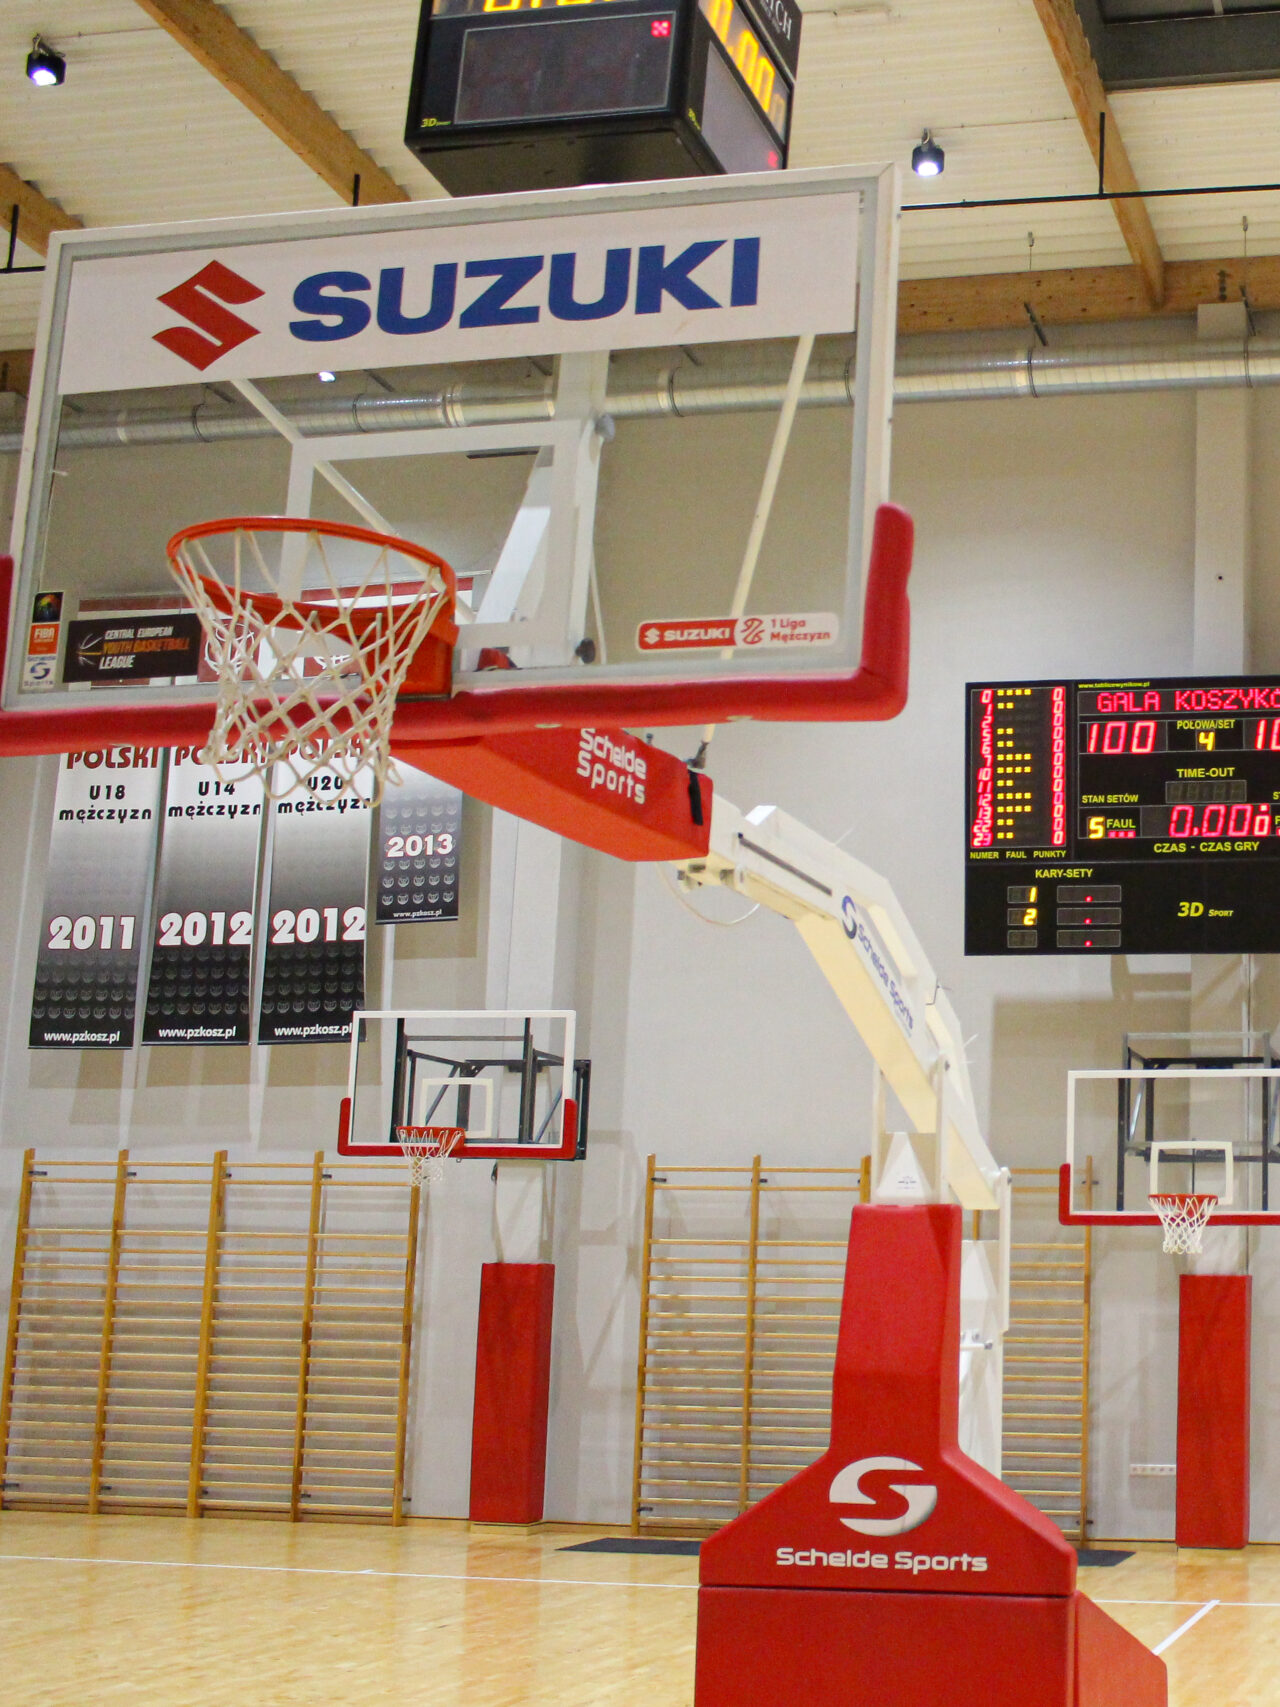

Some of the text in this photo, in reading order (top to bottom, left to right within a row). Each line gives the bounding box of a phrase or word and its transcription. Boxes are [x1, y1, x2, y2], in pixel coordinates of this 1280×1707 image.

[289, 237, 760, 341] SUZUKI
[780, 618, 806, 630] Liga
[663, 628, 730, 641] SUZUKI
[99, 655, 136, 669] LEAGUE
[1097, 691, 1160, 712] GALA
[1176, 719, 1235, 730] POŁOWA/SET
[1087, 720, 1157, 753] 100
[1198, 731, 1215, 751] 4
[66, 746, 159, 769] POLSKI
[579, 728, 647, 779] Schelde
[576, 750, 645, 804] Sports
[1176, 767, 1235, 778] TIME-OUT
[89, 785, 126, 800] U18
[198, 781, 236, 796] U14
[1082, 794, 1139, 803] STAN SETÓW
[1106, 819, 1136, 828] FAUL
[386, 833, 453, 858] 2013
[1154, 843, 1186, 853] CZAS
[1200, 842, 1231, 852] CZAS
[1234, 841, 1259, 851] GRY
[970, 851, 999, 859] NUMER
[1033, 850, 1066, 858] PUNKTY
[1035, 869, 1093, 878] KARY-SETY
[1029, 886, 1037, 902] 1
[1023, 908, 1037, 925] 2
[1177, 902, 1203, 917] 3D
[47, 915, 136, 950] 2011
[158, 911, 252, 946] 2012
[271, 906, 366, 944] 2012
[44, 1030, 120, 1044] www.pzkosz.pl
[158, 1025, 236, 1039] www.pzkosz.pl
[274, 1022, 353, 1037] www.pzkosz.pl
[776, 1548, 988, 1575] Schelde Sports
